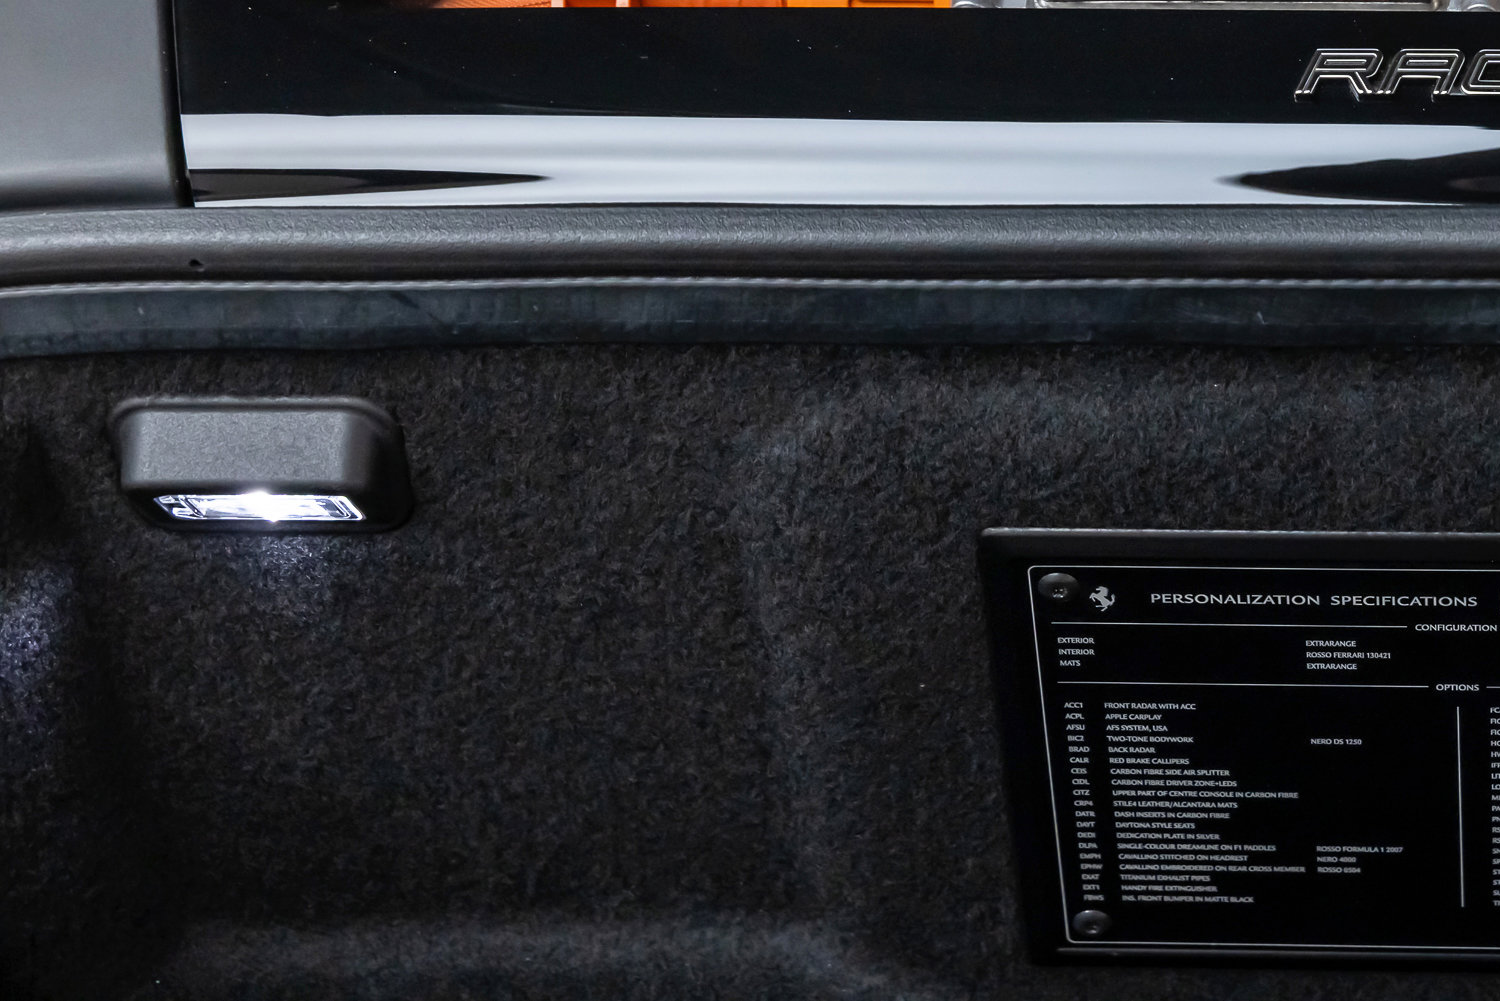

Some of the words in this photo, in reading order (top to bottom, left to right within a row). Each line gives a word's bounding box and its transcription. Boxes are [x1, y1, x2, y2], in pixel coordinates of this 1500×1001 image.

[1150, 593, 1320, 605] PERSONALIZATION
[1330, 595, 1478, 607] SPECIFICATIONS
[1414, 623, 1498, 632] CONFIGURATION
[1305, 640, 1357, 648] EXTRARANGE
[1058, 648, 1095, 656] INTERIOR
[1305, 651, 1332, 659] ROSSO
[1333, 651, 1365, 659] FERRARI
[1059, 659, 1081, 667] MATS
[1306, 662, 1358, 670] EXTRARANGE
[1435, 683, 1480, 692] OPTIONS
[1130, 702, 1158, 710] RADAR
[1128, 713, 1163, 721] CARPLAY
[1105, 735, 1149, 743] TWO-TONE
[1128, 746, 1156, 754] RADAR
[1125, 757, 1151, 765] BRAKE
[1151, 757, 1190, 765] CALLIPERS
[1143, 768, 1165, 776] FIBRE
[1196, 769, 1230, 777] SPLITTER
[1110, 778, 1144, 786] CARBON
[1165, 779, 1194, 787] DRIVER
[1112, 789, 1137, 797] UPPER
[1198, 790, 1235, 798] CONSOLE
[1244, 791, 1277, 799] CARBON
[1277, 791, 1299, 799] FIBRE
